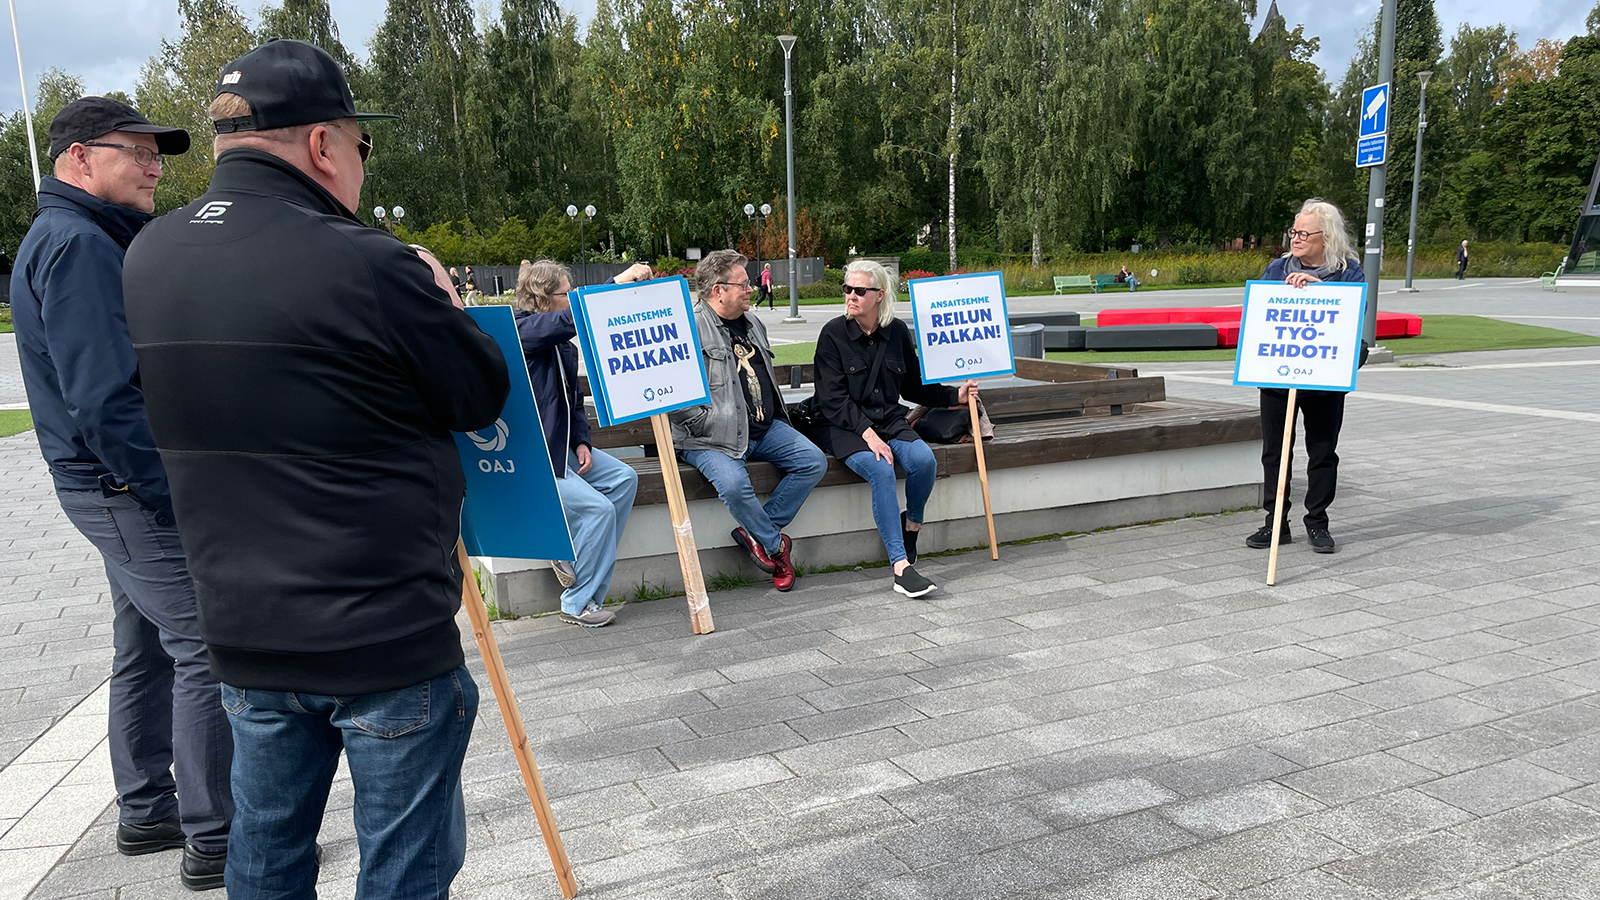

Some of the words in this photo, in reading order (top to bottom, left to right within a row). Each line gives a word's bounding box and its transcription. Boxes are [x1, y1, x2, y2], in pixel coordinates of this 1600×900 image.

[930, 296, 990, 309] ANSAITSEMME
[1267, 297, 1341, 306] ANSAITSEMME
[607, 307, 673, 328] ANSAITSEMME
[931, 308, 993, 328] REILUN
[1265, 308, 1340, 324] REILUT
[609, 322, 679, 352] REILUN
[926, 325, 1002, 347] PALKAN!
[1274, 323, 1325, 341] TYÖ-
[607, 343, 691, 376] PALKAN!
[1257, 343, 1338, 360] EHDOT!
[967, 357, 983, 366] OAJ
[1293, 368, 1313, 376] OAJ
[657, 385, 674, 396] OAJ
[478, 459, 515, 473] OAJ
